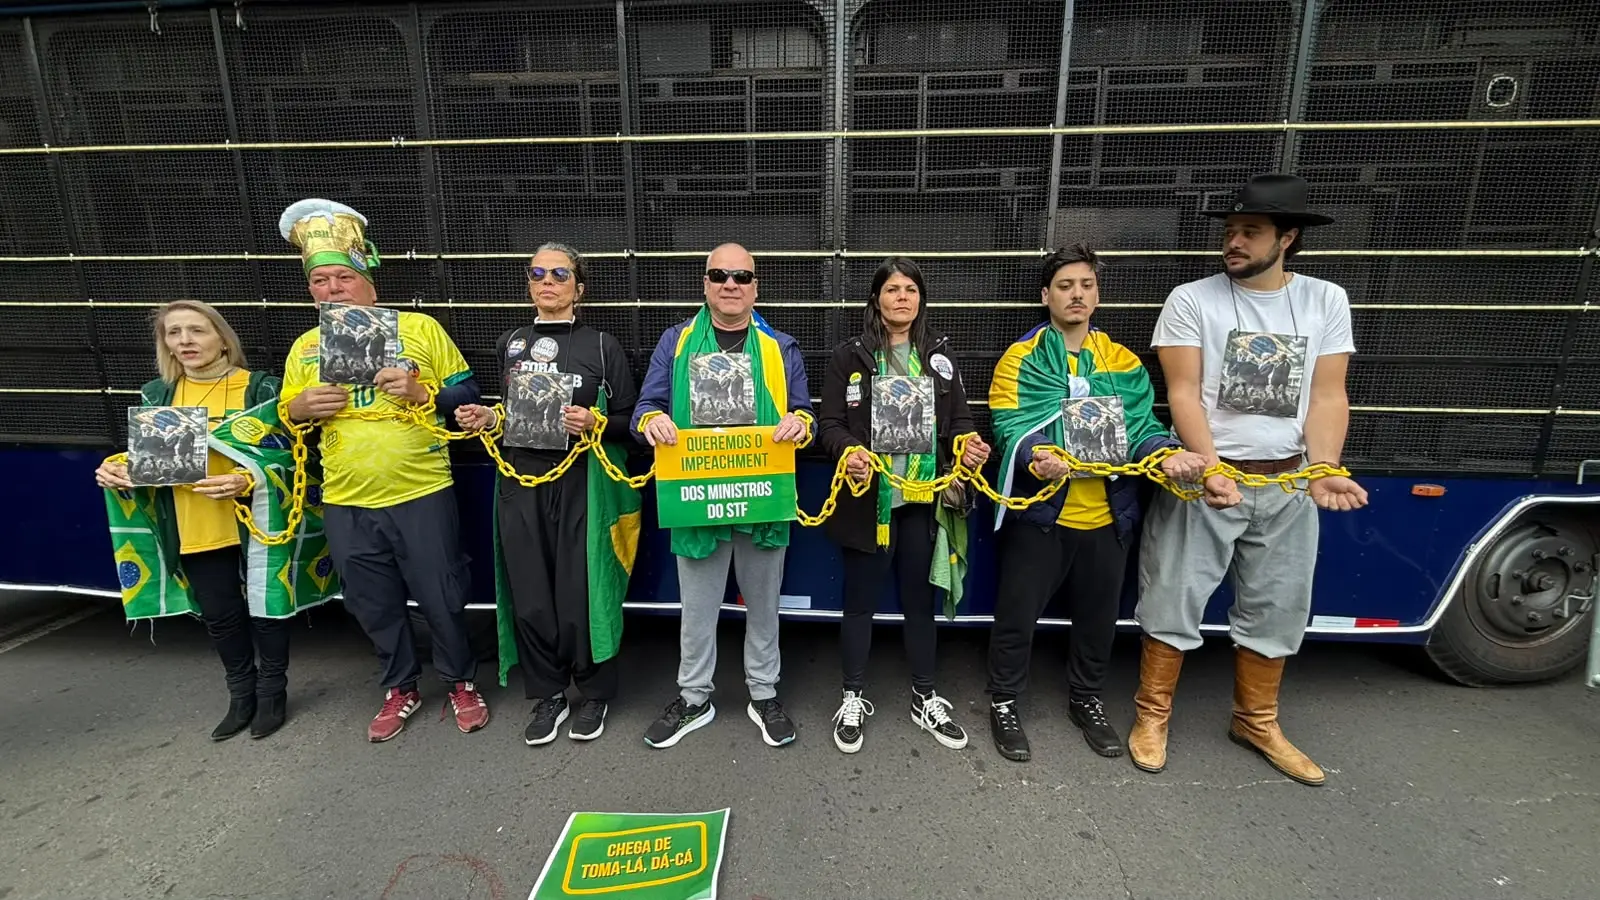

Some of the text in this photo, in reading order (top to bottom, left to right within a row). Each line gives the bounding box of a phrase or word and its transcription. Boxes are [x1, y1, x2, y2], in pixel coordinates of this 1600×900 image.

[520, 360, 559, 373] FORA
[686, 433, 763, 452] QUEREMOS O
[681, 452, 769, 471] IMPEACHMENT
[680, 481, 772, 501] DOS MINISTROS
[707, 501, 748, 519] DO STF
[607, 836, 672, 857] CHEGA DE
[581, 848, 693, 879] TOMA-LÁ, DÁ-CÁ
